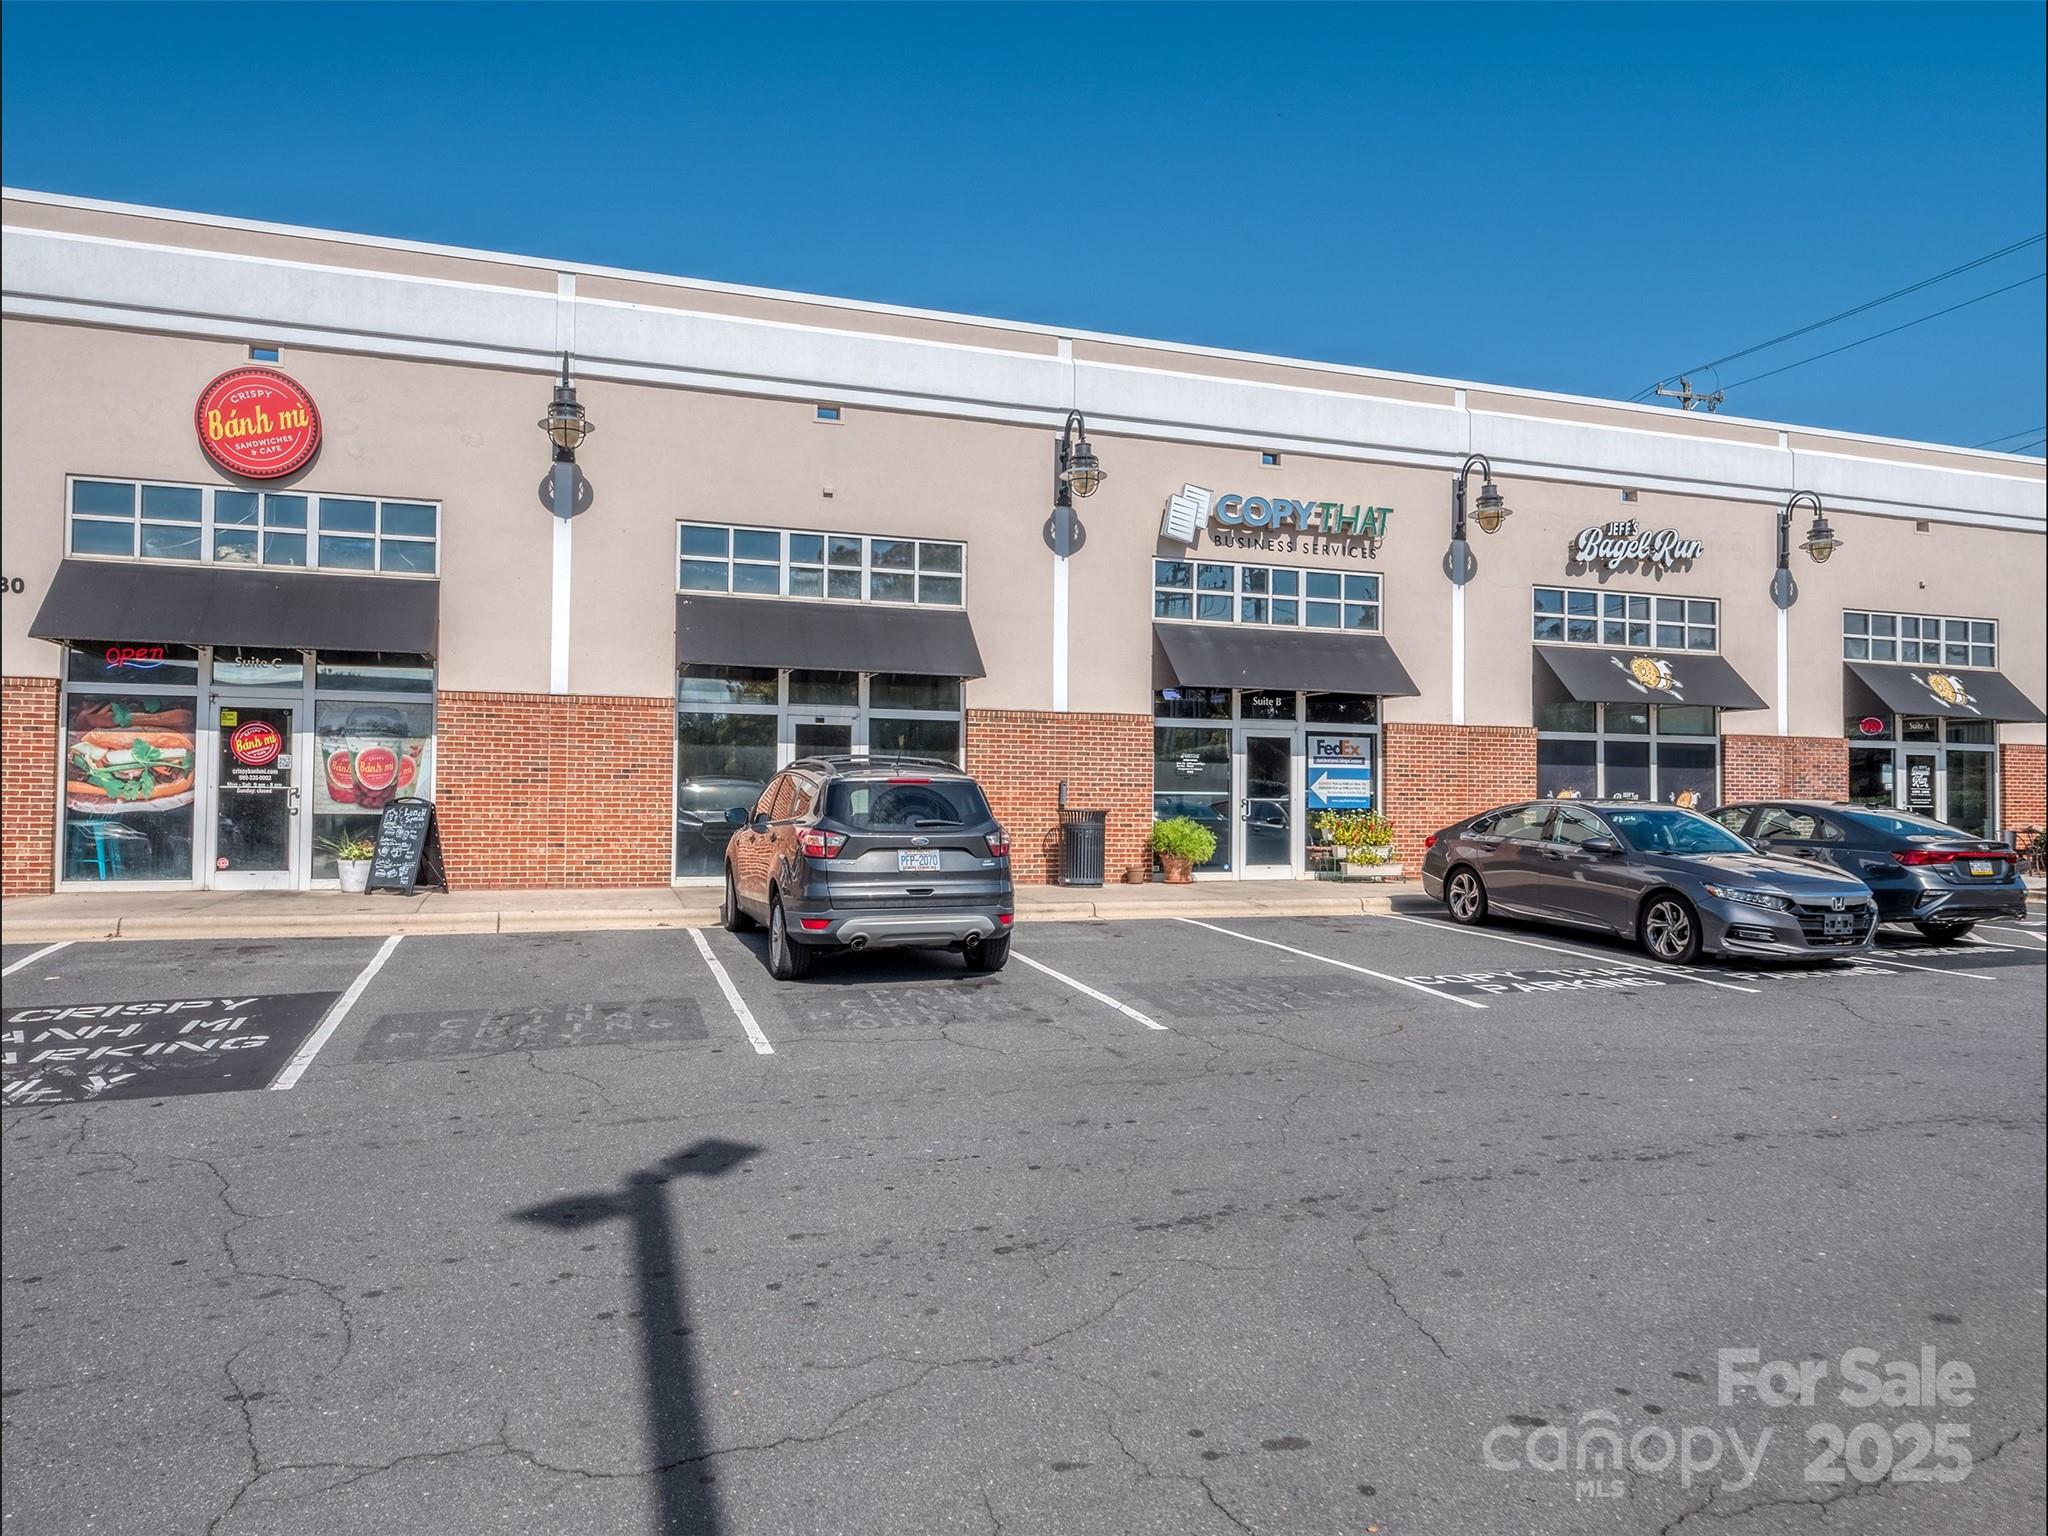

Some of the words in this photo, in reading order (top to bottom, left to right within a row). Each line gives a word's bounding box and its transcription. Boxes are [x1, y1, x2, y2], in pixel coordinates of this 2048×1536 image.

[230, 389, 273, 403] CRISPY
[208, 405, 273, 441] Bánh
[278, 402, 309, 430] mì
[234, 435, 293, 450] SANDWICHES
[259, 445, 282, 455] CAFE
[1607, 518, 1640, 536] JEFF'S
[1214, 535, 1294, 553] BUSINESS
[1303, 542, 1377, 560] SERVICES
[1575, 527, 1653, 570] Bagel
[1652, 528, 1703, 568] Run
[234, 656, 267, 669] Suite
[272, 657, 283, 669] C
[1252, 696, 1274, 706] Suite
[1275, 697, 1282, 706] B
[1908, 721, 1923, 730] Suite
[1924, 722, 1930, 730] A
[236, 736, 263, 752] Bánh
[1316, 739, 1361, 755] FedEx
[901, 854, 938, 866] PFP-2070
[1404, 971, 1526, 985] COPY
[1472, 976, 1667, 994] PARKING
[8, 998, 259, 1023] CRISPY
[178, 1016, 248, 1034] MI
